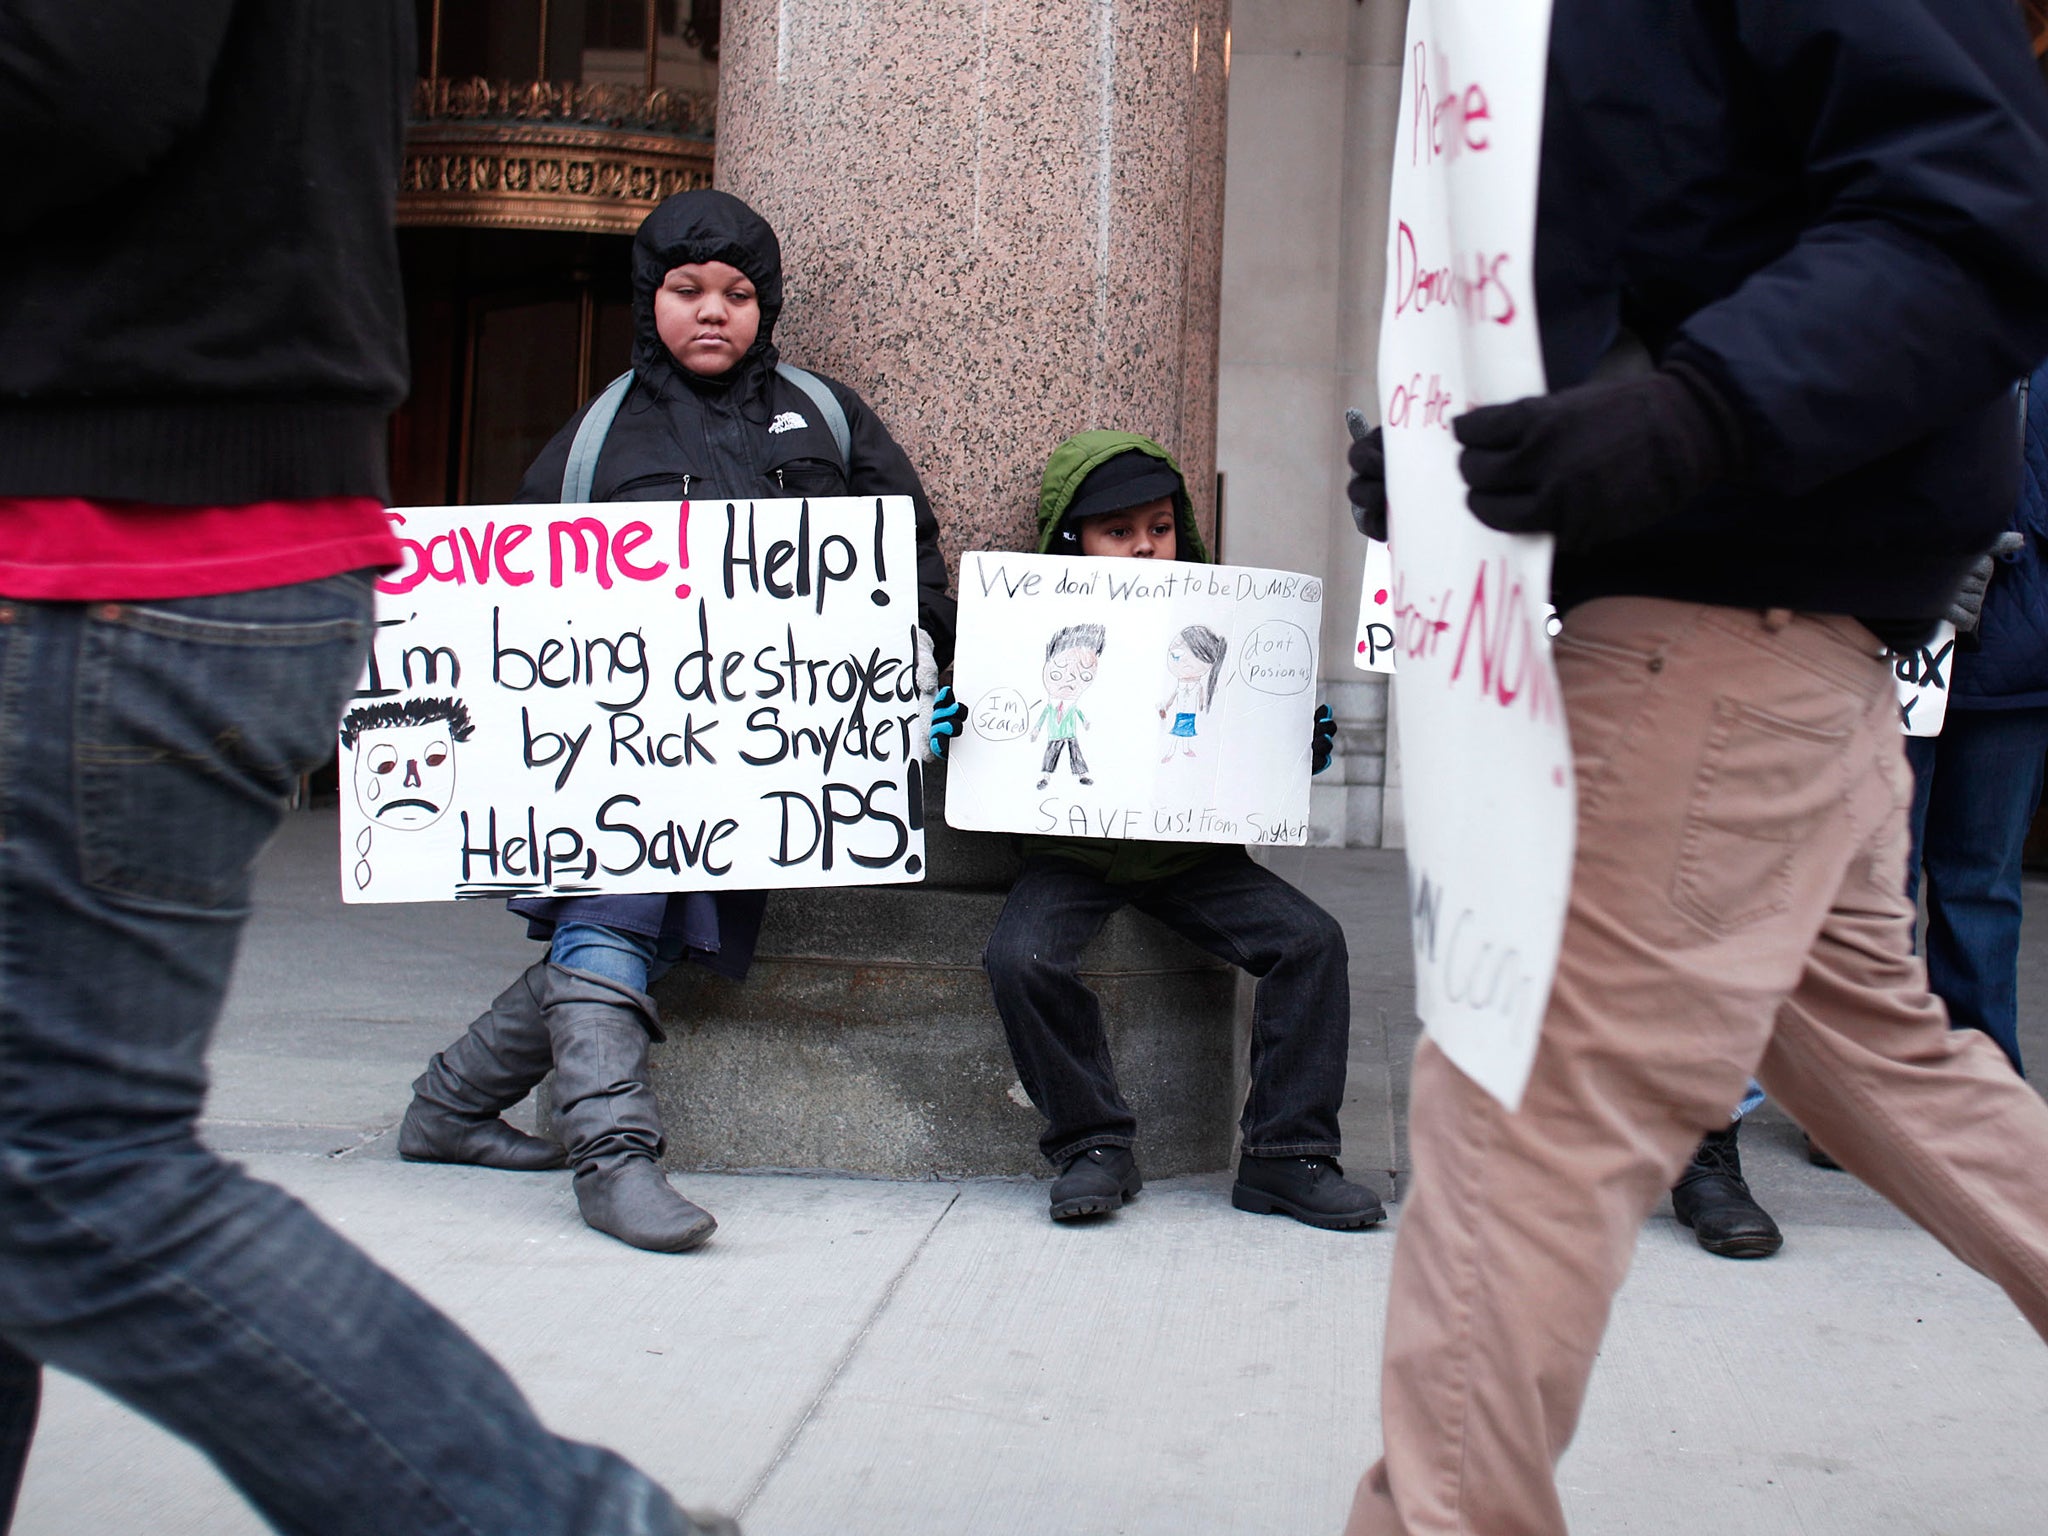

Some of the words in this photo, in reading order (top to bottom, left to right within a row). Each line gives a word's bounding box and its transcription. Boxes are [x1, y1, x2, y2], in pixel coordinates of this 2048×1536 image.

[374, 513, 533, 595] Save
[549, 500, 692, 599] me!
[724, 498, 891, 615] Help!
[976, 555, 1042, 598] We
[1109, 572, 1178, 600] Want
[1184, 569, 1202, 596] to
[1208, 571, 1232, 596] be
[352, 612, 462, 699] I'm
[492, 607, 651, 709] being
[675, 597, 920, 728] destroyed
[1886, 639, 1954, 690] ax
[521, 706, 593, 793] by
[610, 711, 720, 767] Rick
[738, 706, 920, 776] Snyder
[461, 805, 597, 886] Help,
[597, 794, 740, 876] Save
[761, 760, 924, 875] DPS!
[1035, 797, 1142, 841] SAVE
